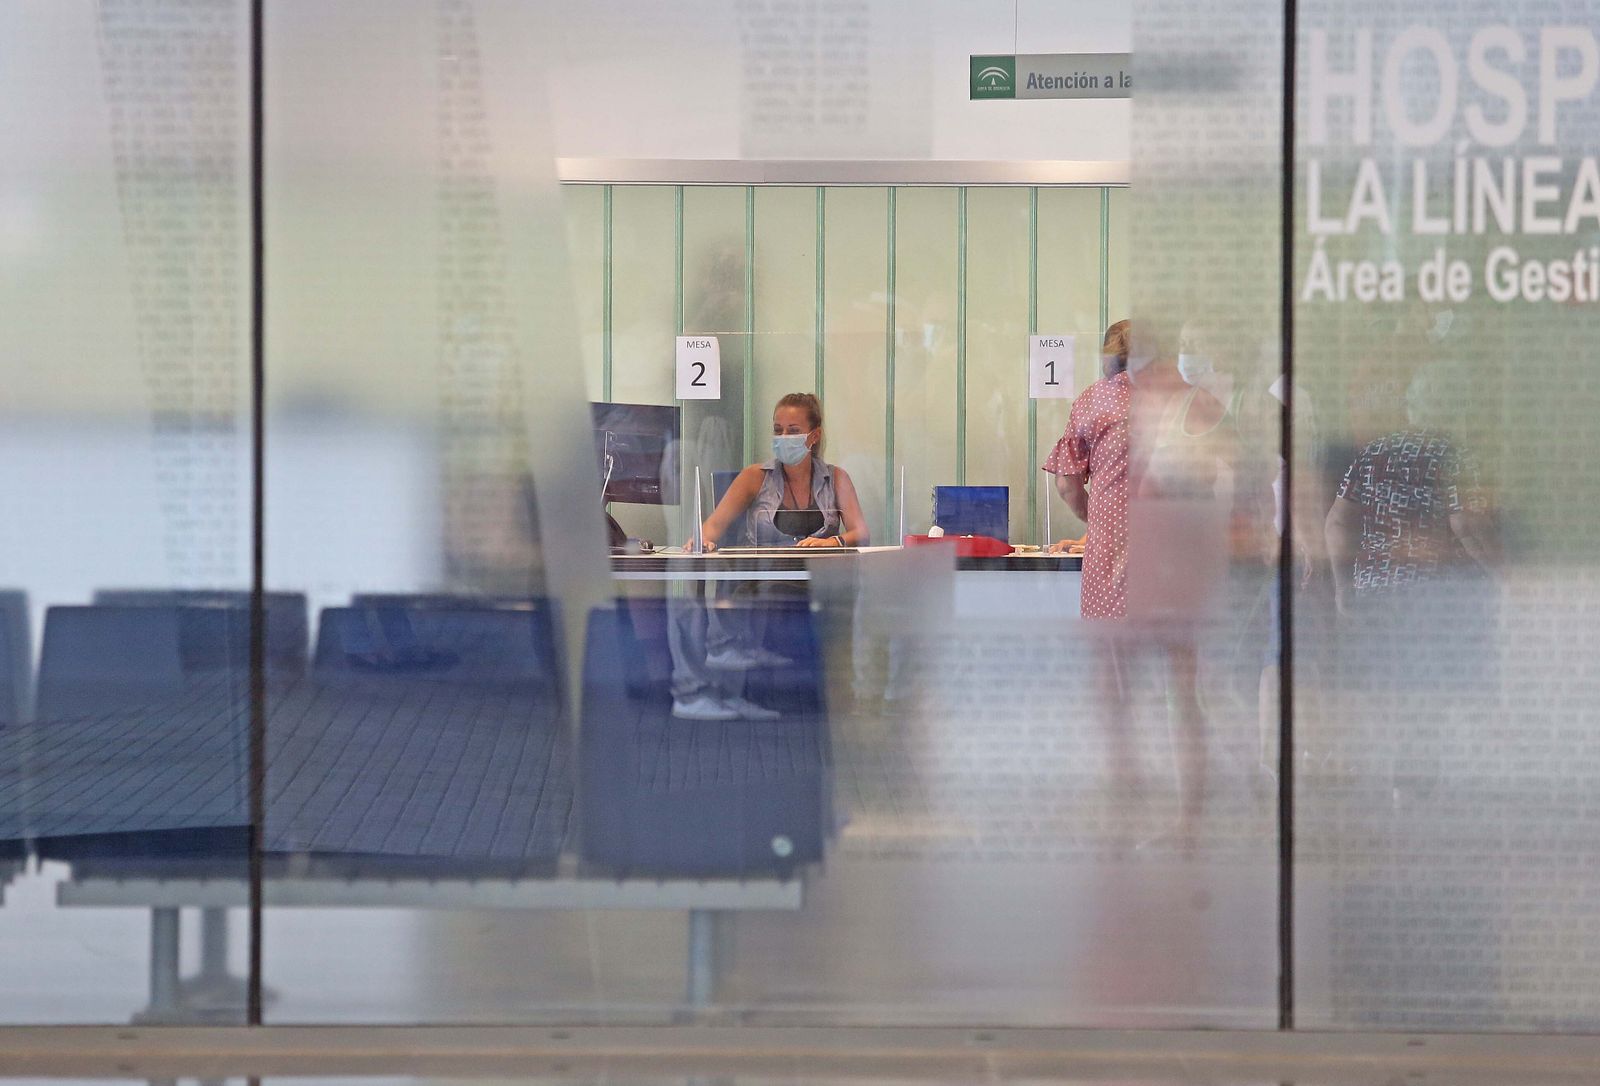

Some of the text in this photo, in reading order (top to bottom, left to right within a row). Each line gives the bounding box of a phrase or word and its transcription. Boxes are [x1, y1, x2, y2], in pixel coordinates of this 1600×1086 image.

[1026, 72, 1098, 90] Atención
[1104, 75, 1114, 89] a
[1309, 24, 1599, 147] HOSP
[1307, 139, 1600, 235] LA LÍNEA
[1302, 236, 1599, 302] Área de Gesti
[686, 340, 711, 349] MESA
[1040, 339, 1065, 348] MESA
[691, 361, 707, 387] 2
[1044, 360, 1060, 386] 1
